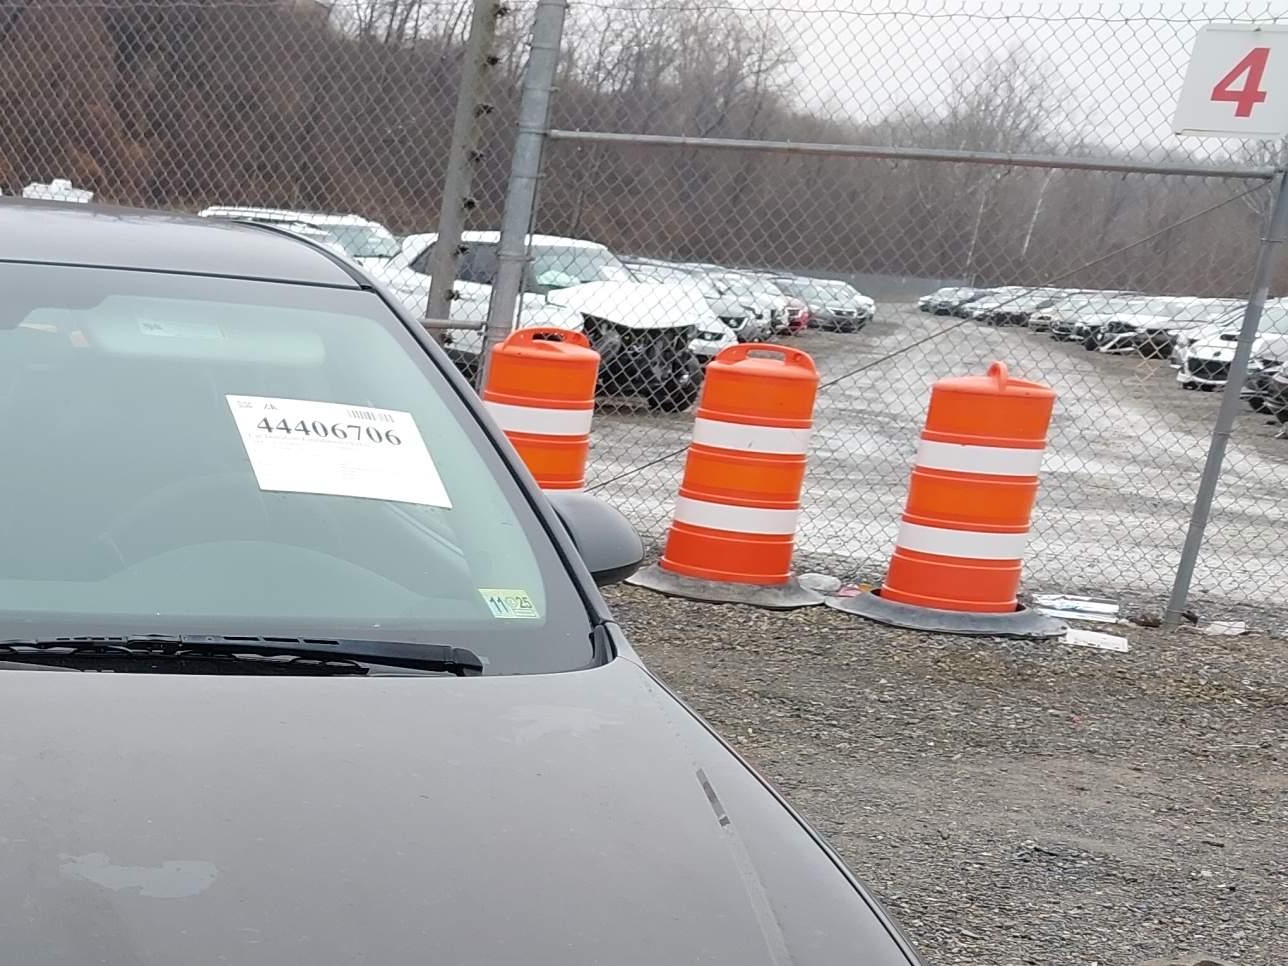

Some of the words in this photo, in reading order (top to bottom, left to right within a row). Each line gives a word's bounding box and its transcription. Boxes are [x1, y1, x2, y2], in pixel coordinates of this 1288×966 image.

[1210, 47, 1272, 118] 4
[256, 416, 403, 446] 44406706
[489, 597, 510, 614] 11
